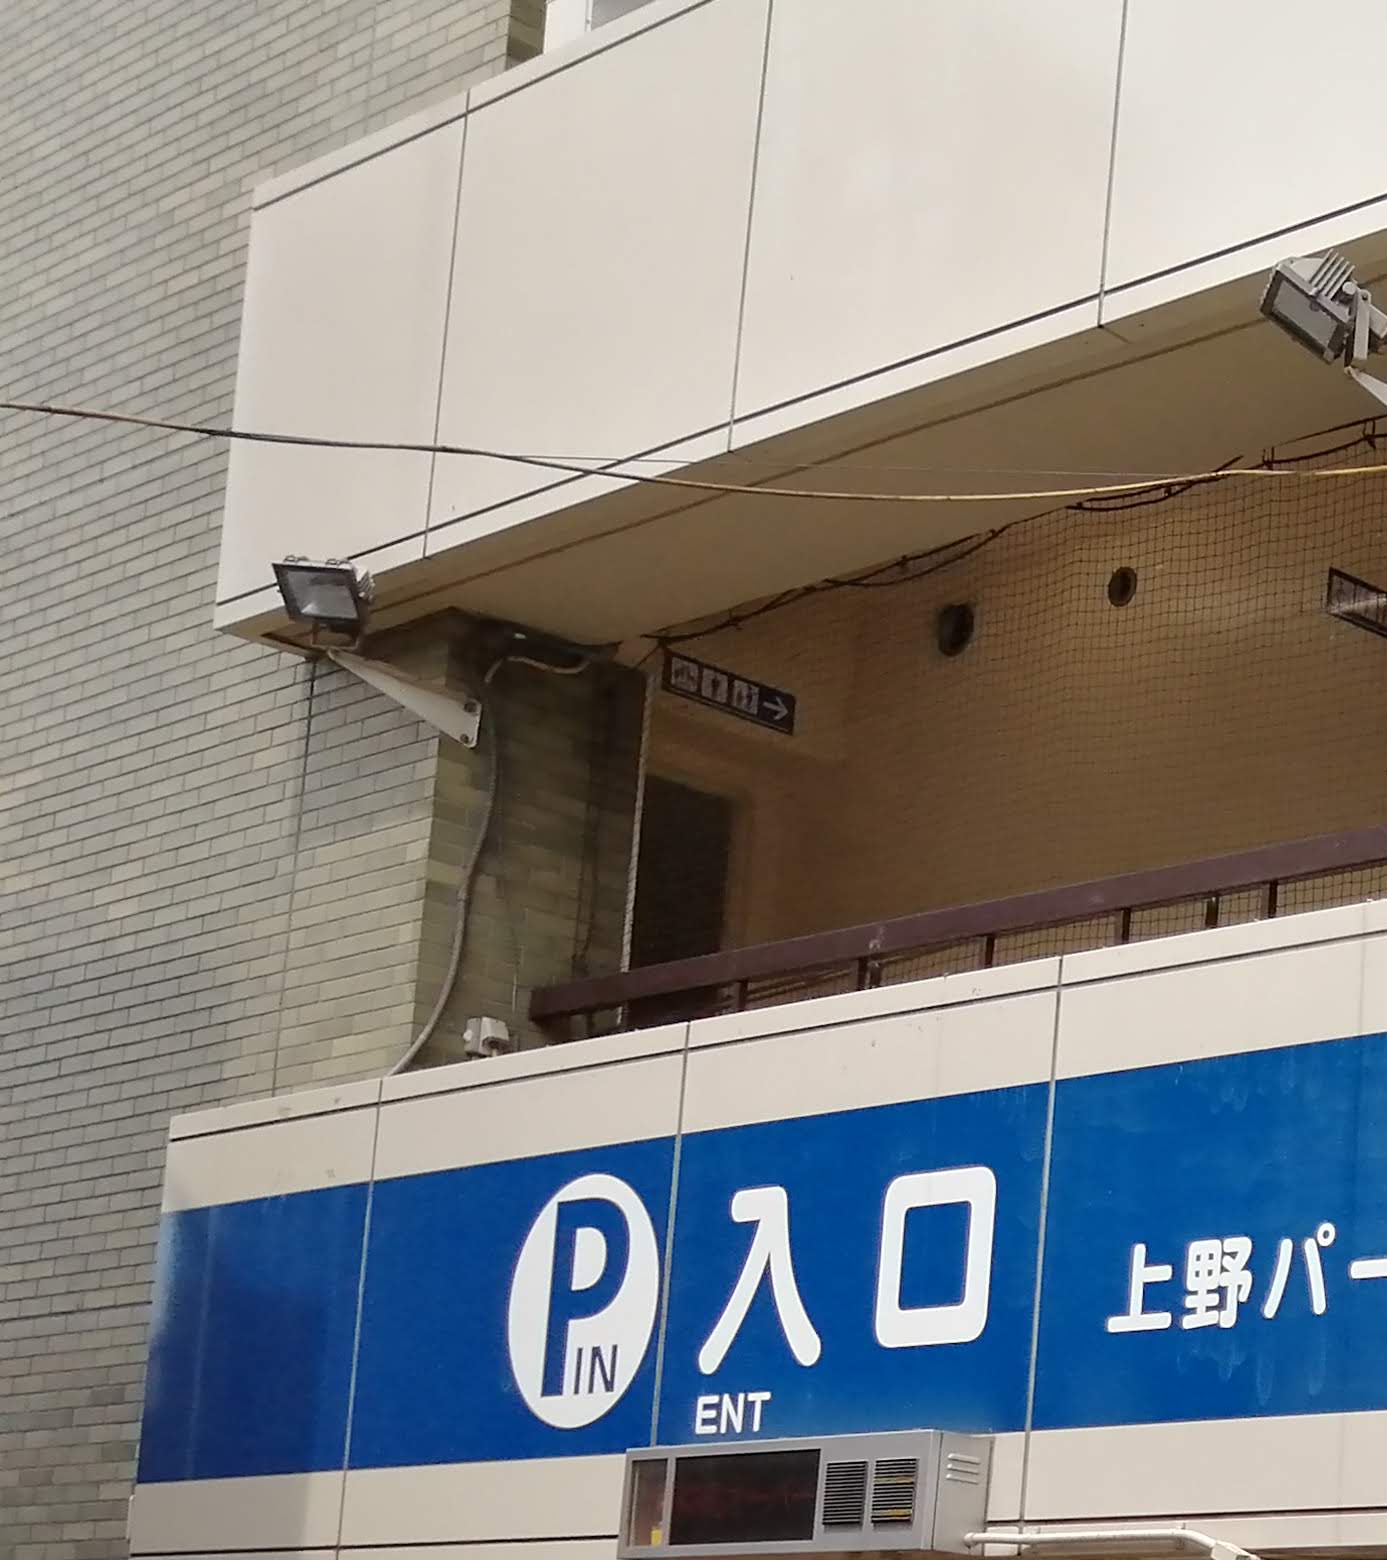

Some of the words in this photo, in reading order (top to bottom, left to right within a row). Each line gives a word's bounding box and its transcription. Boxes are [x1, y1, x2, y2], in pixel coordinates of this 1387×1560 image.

[698, 1165, 998, 1376] 入口
[573, 1344, 619, 1396] IN
[694, 1390, 772, 1436] ENT
